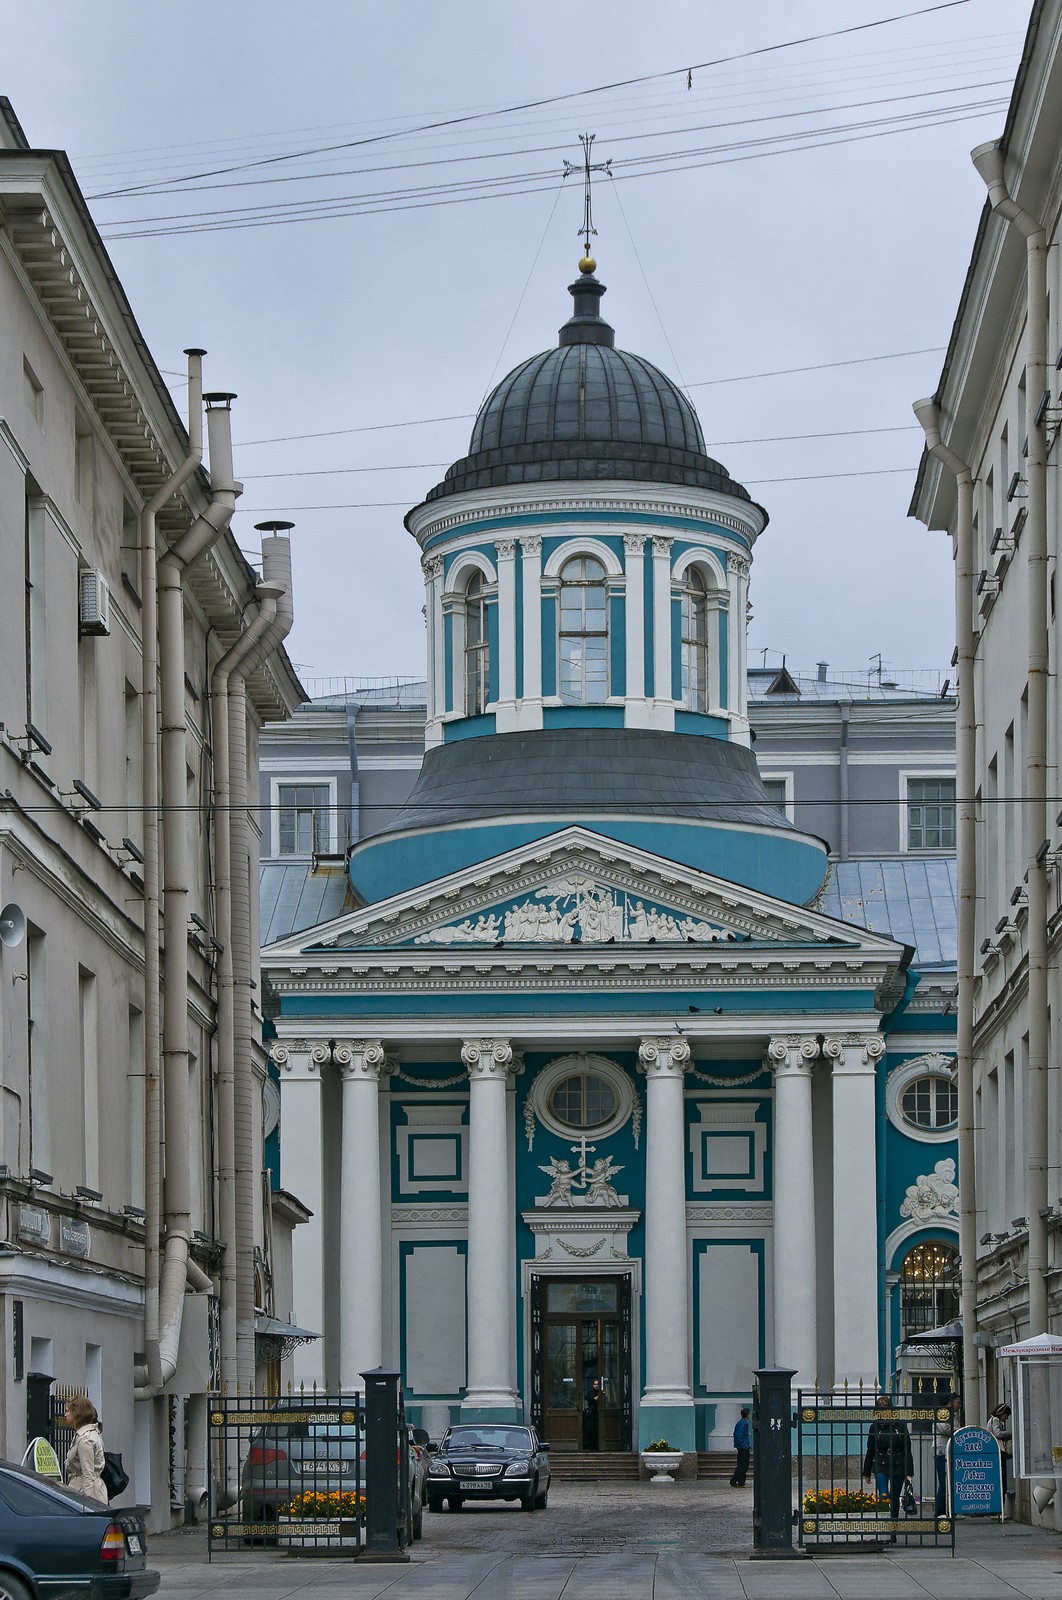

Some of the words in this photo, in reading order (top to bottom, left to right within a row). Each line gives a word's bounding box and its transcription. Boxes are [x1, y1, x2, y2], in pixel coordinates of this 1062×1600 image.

[955, 1431, 991, 1446] Армянский
[964, 1440, 982, 1451] хлеб
[955, 1482, 995, 1494] Восточные
[960, 1491, 991, 1501] сладости
